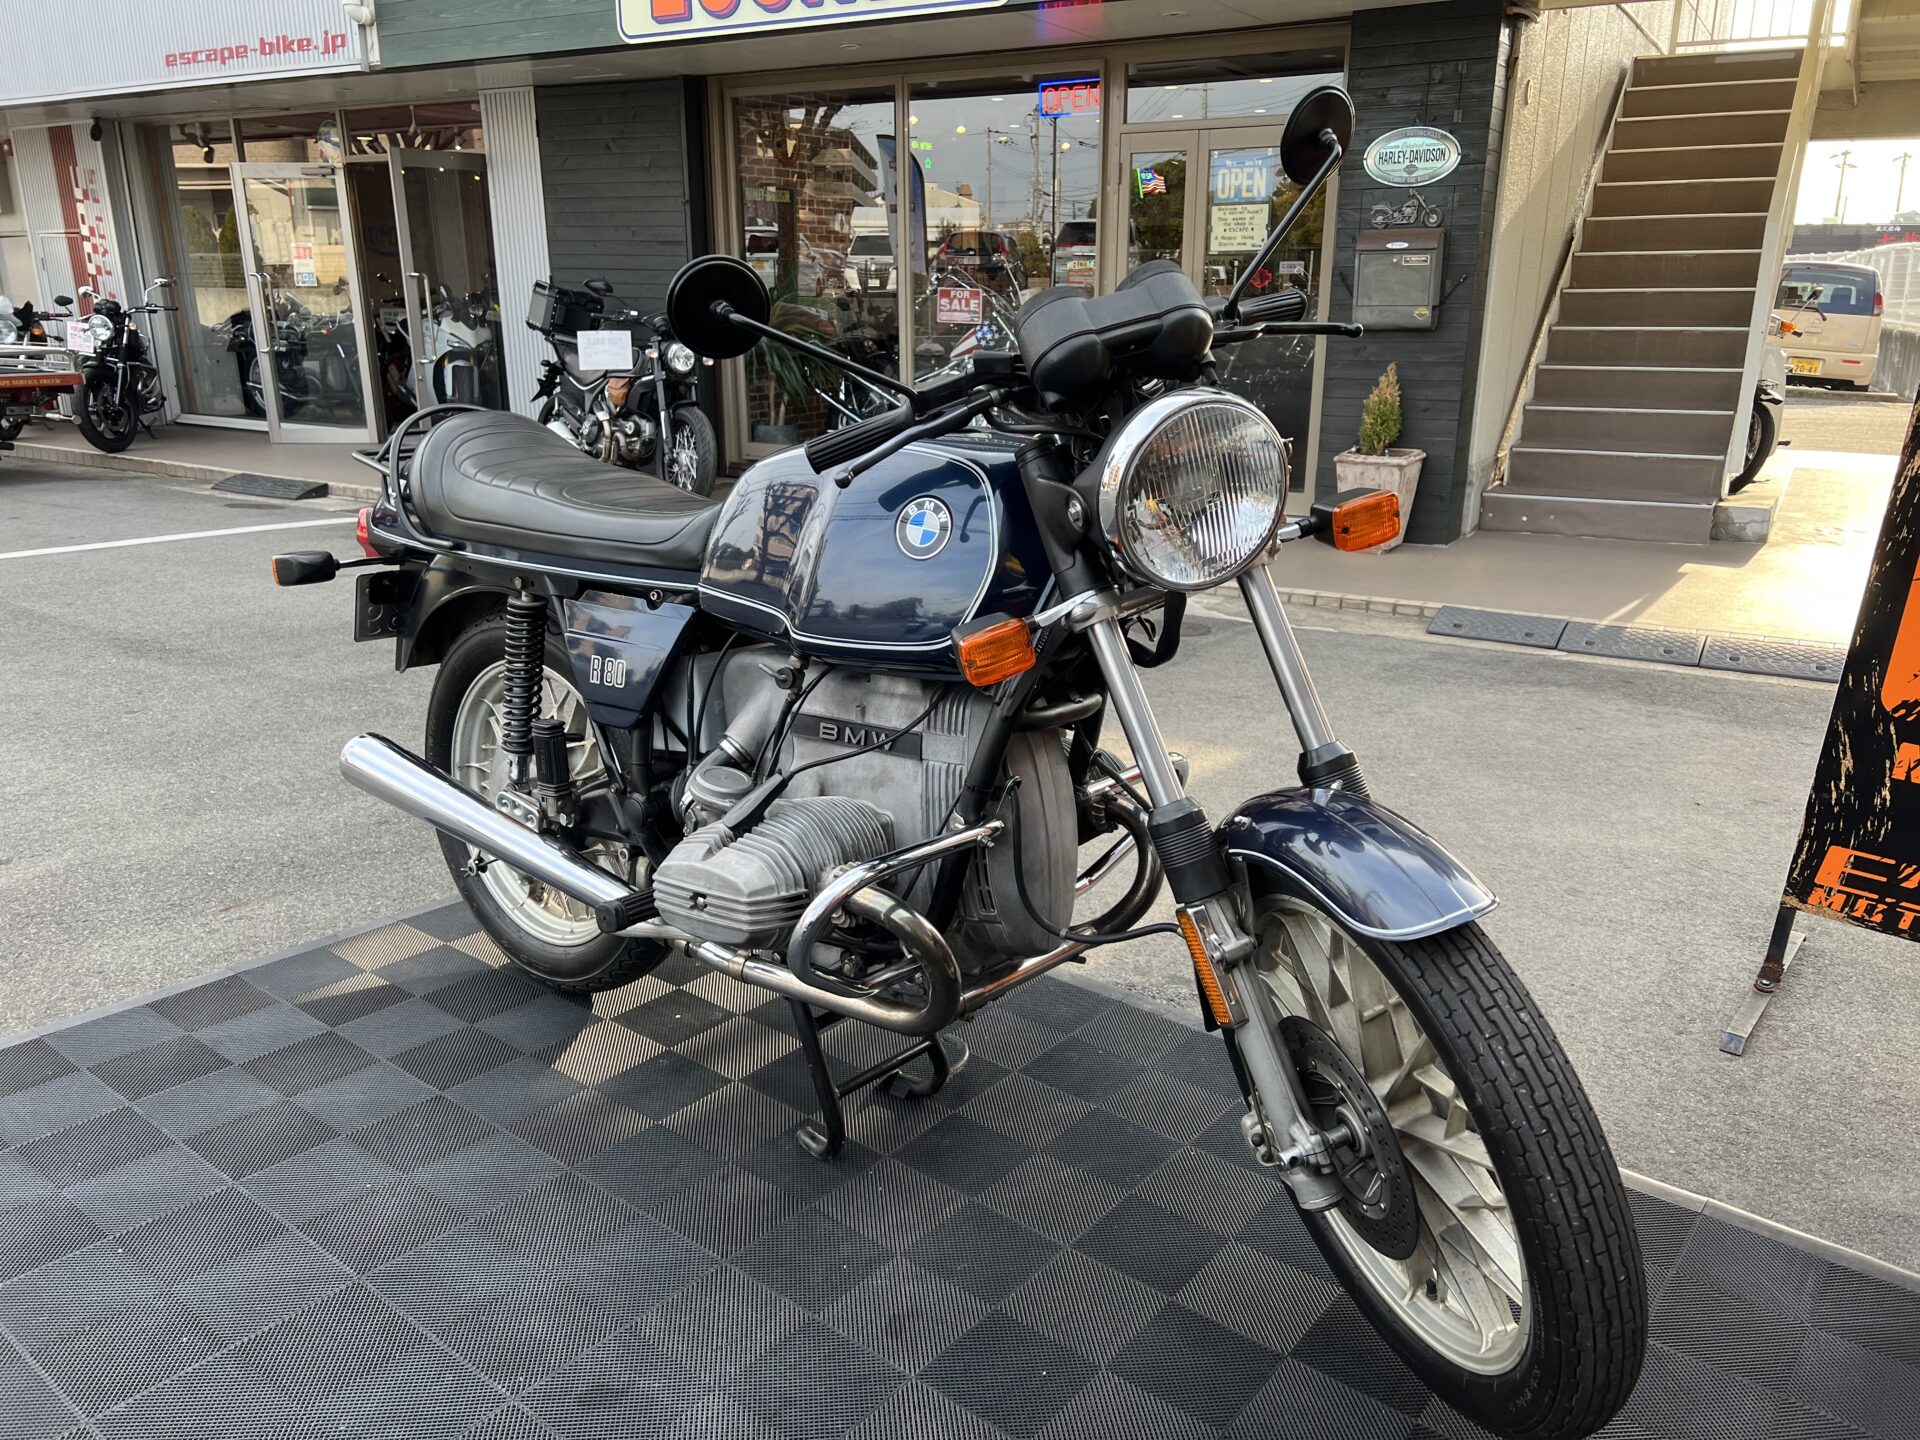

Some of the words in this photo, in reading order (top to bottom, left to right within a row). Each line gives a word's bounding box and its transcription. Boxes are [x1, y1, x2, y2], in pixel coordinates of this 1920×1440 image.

[165, 30, 346, 67] escape-bike.jp
[1044, 84, 1101, 112] OPEN
[1378, 148, 1447, 165] HARLEY-DAVIDSON
[1217, 167, 1267, 199] OPEN
[940, 299, 979, 312] SALE
[950, 290, 970, 299] FOR
[907, 500, 948, 522] BMW
[590, 655, 602, 684] R
[603, 657, 627, 688] 80
[819, 722, 893, 751] BMW
